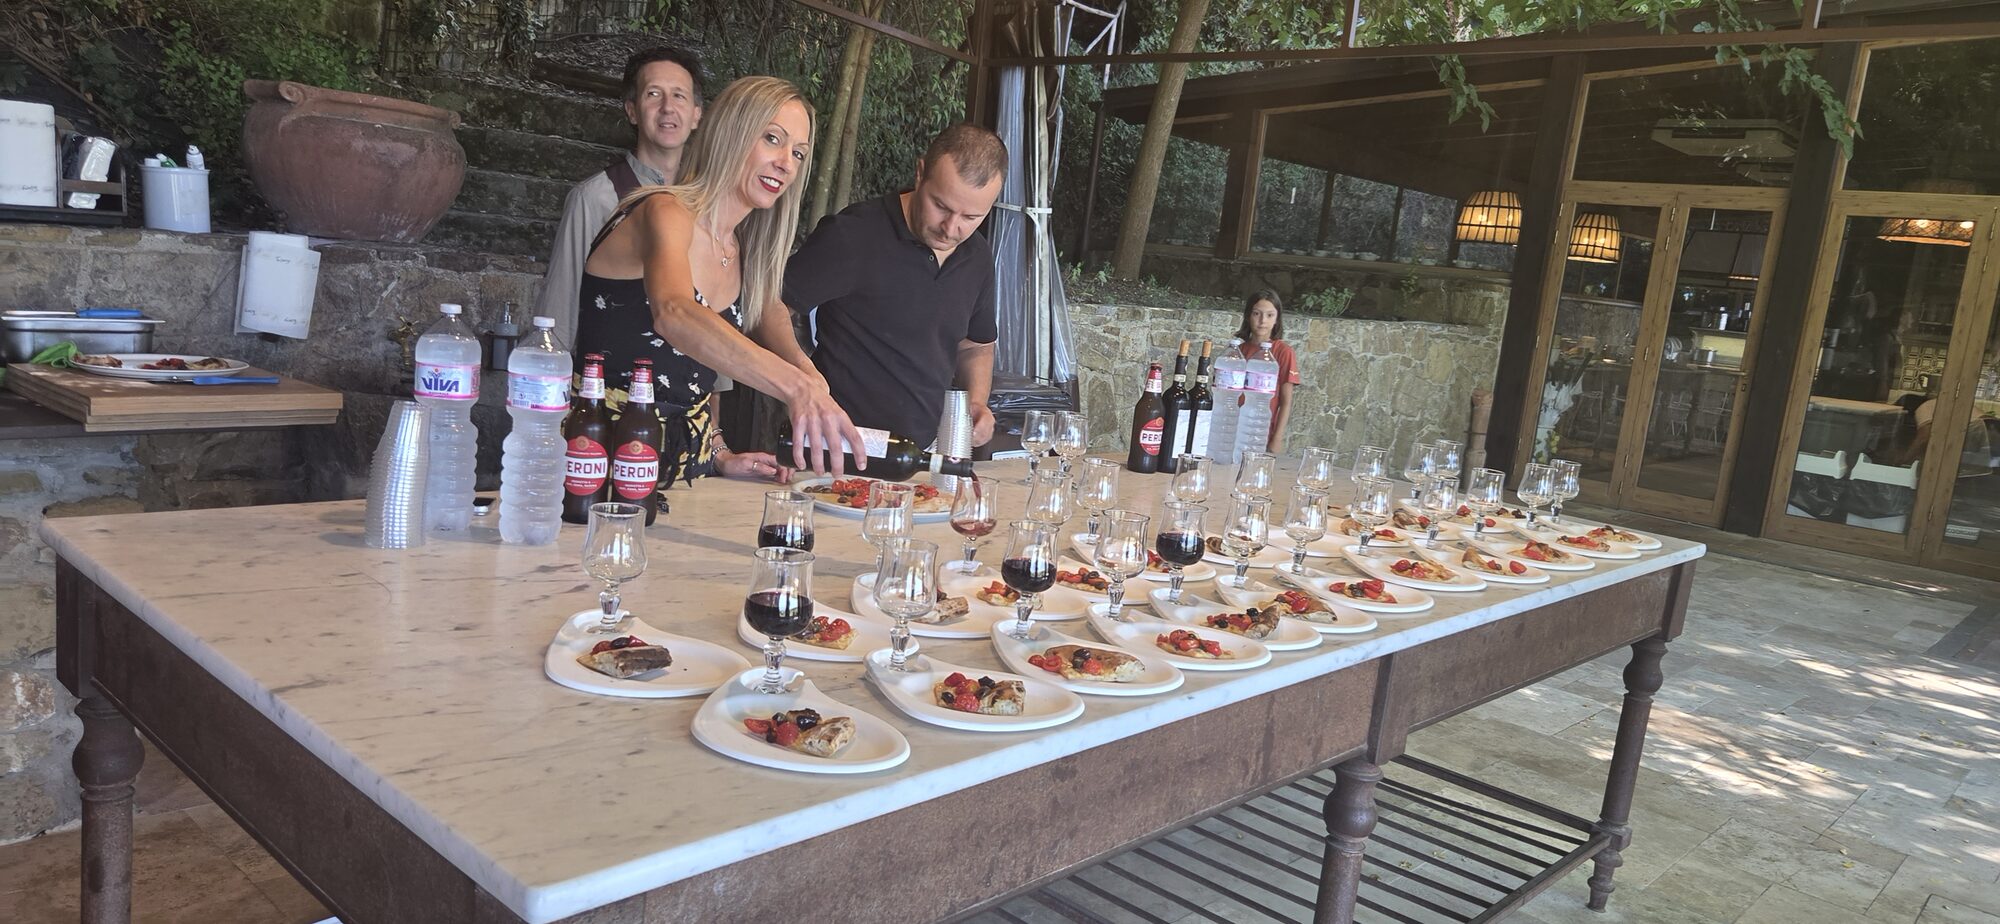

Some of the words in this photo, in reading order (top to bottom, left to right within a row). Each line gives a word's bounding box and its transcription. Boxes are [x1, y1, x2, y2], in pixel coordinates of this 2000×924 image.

[421, 375, 459, 392] VIVA
[1142, 433, 1162, 442] PERO
[567, 461, 606, 474] ERONI
[614, 464, 657, 477] PERONI
